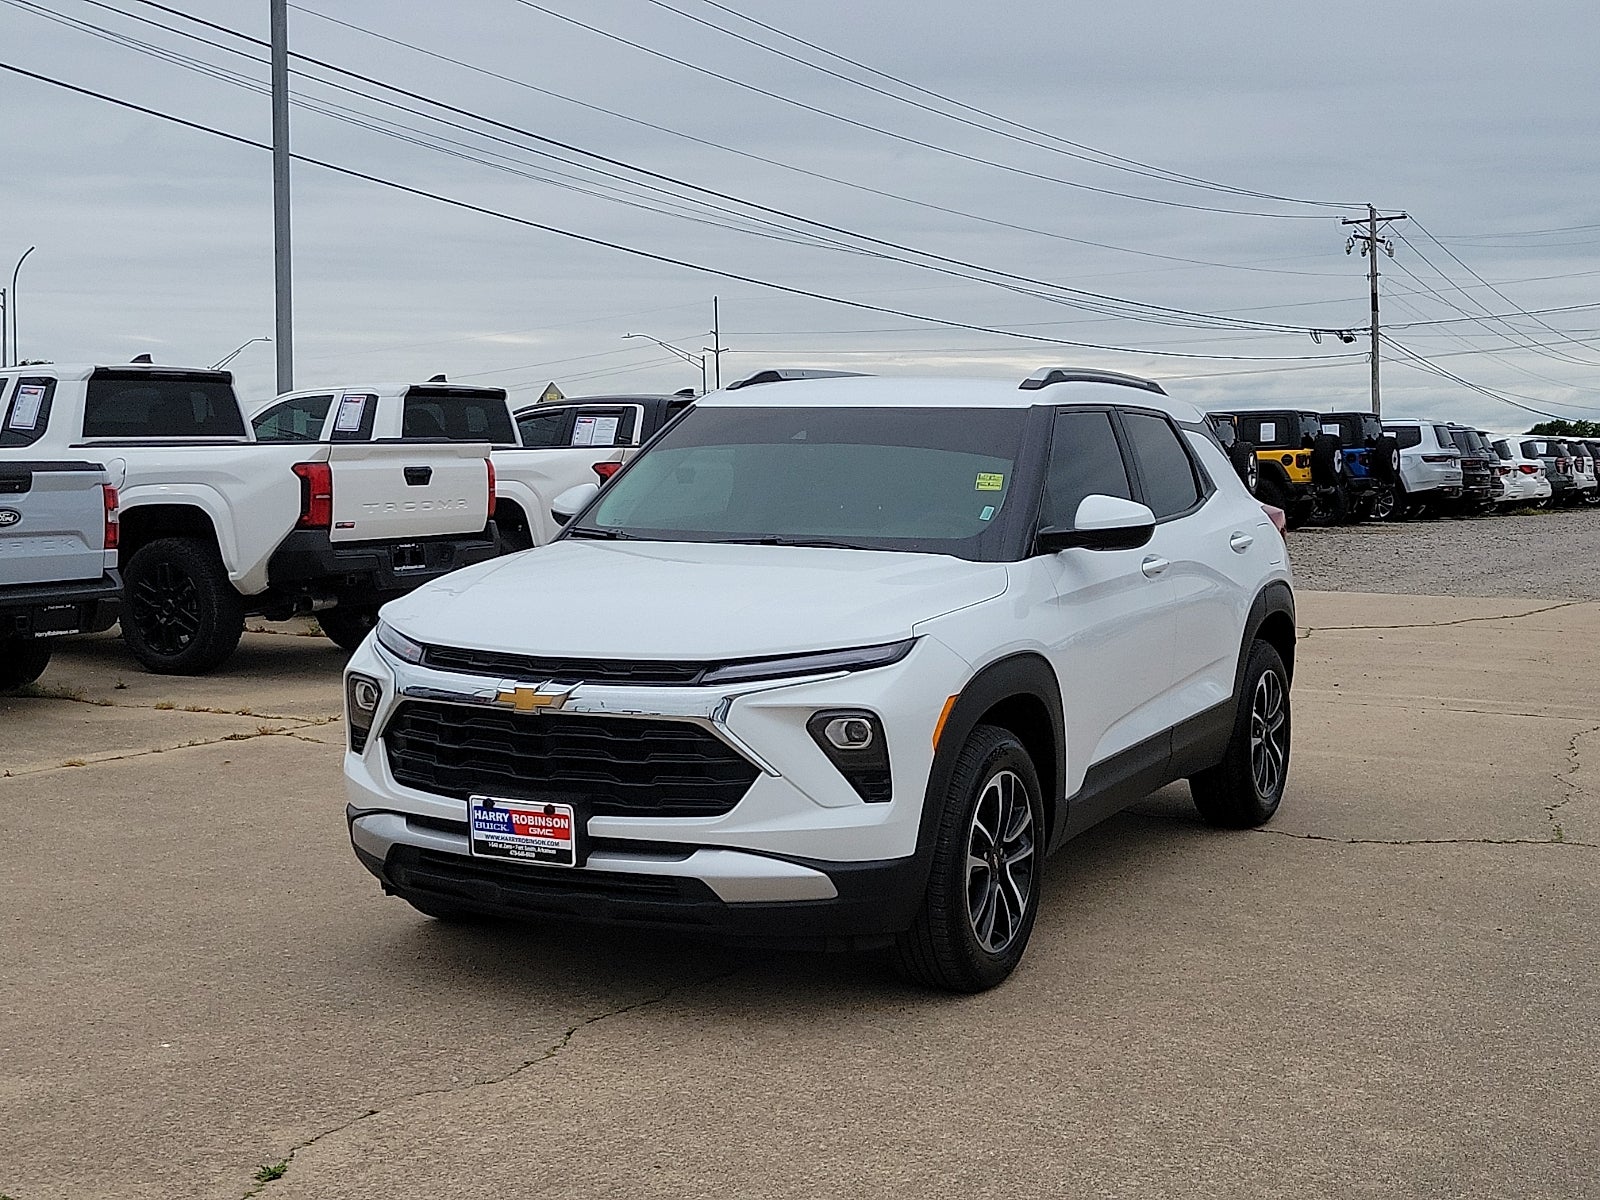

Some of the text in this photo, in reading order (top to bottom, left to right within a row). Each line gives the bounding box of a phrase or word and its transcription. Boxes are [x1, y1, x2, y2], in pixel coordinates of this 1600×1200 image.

[362, 498, 468, 514] TACOMA
[474, 809, 569, 829] HARRY ROBINSON
[475, 821, 509, 832] BUICK
[528, 827, 555, 836] GMC
[484, 834, 560, 847] WWW.HARRYROBINSON.COM
